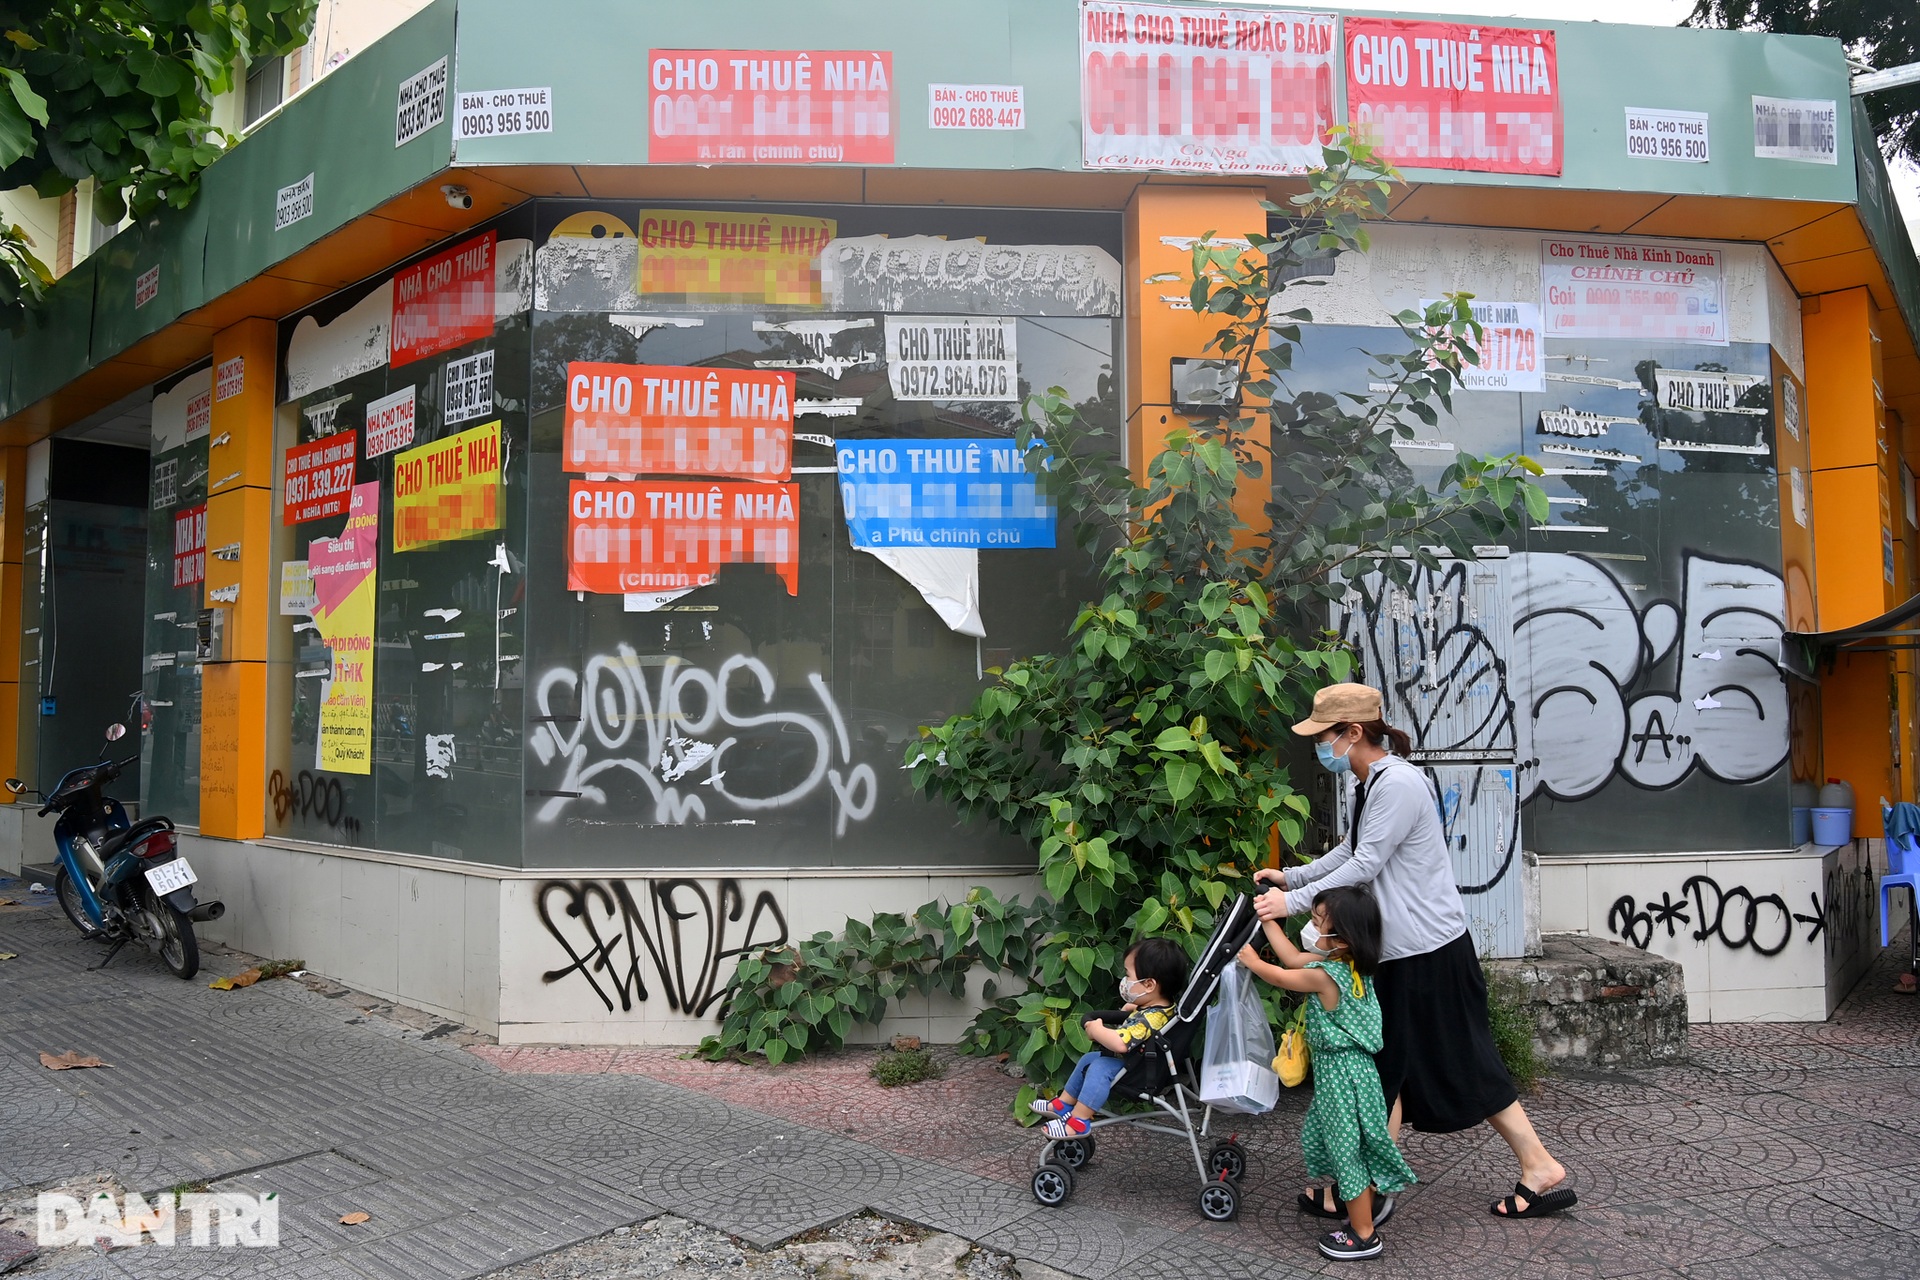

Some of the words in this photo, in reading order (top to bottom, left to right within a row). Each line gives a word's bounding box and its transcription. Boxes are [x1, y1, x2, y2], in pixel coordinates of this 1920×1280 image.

[1087, 6, 1128, 44] NHÀ
[1135, 13, 1174, 45] CHO
[1180, 12, 1229, 50] THUÊ
[1235, 14, 1288, 59] HOẶC
[1293, 17, 1332, 55] BÁN
[652, 58, 719, 91] CHO
[729, 52, 812, 91] THUÊ
[824, 52, 889, 91] NHÀ
[1353, 33, 1409, 87] CHO
[1414, 29, 1484, 92] THUÊ
[1491, 33, 1551, 96] NHÀ
[399, 80, 413, 107] NHÀ
[413, 75, 428, 99] CHO
[428, 60, 446, 90] THUÊ
[935, 87, 956, 102] BÁN
[965, 90, 988, 102] CHO
[990, 88, 1019, 103] THUÊ
[397, 104, 416, 141] 0933
[415, 95, 430, 132] 957
[430, 86, 445, 124] 550
[463, 94, 484, 110] BÁN
[493, 94, 515, 108] CHO
[517, 90, 547, 105] THUÊ
[461, 113, 495, 137] 0903
[497, 111, 522, 133] 956
[525, 110, 550, 131] 500
[934, 107, 966, 127] 0902
[1629, 117, 1649, 132] BÁN
[1656, 121, 1677, 133] CHO
[1679, 121, 1704, 136] THUÊ
[1180, 143, 1204, 157] Cô
[1211, 146, 1249, 161] Nga
[1629, 135, 1658, 155] 0903
[1661, 137, 1683, 158] 956
[1685, 139, 1707, 159] 500
[1219, 161, 1250, 172] cho
[642, 217, 696, 250] CHO
[704, 216, 770, 253] THUÊ
[780, 220, 831, 260] NHÀ
[399, 265, 422, 305] NHÀ
[427, 259, 452, 292] CHO
[455, 235, 491, 280] THUÊ
[1549, 243, 1575, 258] Cho
[1577, 244, 1610, 260] Thuê
[1613, 246, 1639, 261] Nhà
[1642, 248, 1673, 263] Kinh
[1675, 250, 1716, 267] Doanh
[1571, 265, 1643, 282] CHÍNH
[1649, 268, 1696, 286] CHỦ
[1468, 305, 1494, 324] HUÊ
[1495, 305, 1520, 325] NHÀ
[899, 327, 930, 362] CHO
[934, 320, 972, 362] THUÊ
[976, 319, 1006, 361] NHÀ
[448, 365, 459, 384] CHO
[462, 357, 478, 380] THUÊ
[480, 352, 493, 375] NHÀ
[900, 364, 1008, 398] 0972.964.076
[1487, 372, 1508, 388] CHỦ
[464, 378, 478, 407] 957
[570, 374, 633, 413] CHO
[643, 371, 721, 418] THUÊ
[730, 375, 790, 422] NHÀ
[1668, 379, 1695, 409] CHO
[1697, 376, 1731, 410] THUÊ
[367, 409, 381, 434] NHÀ
[381, 406, 395, 429] CHO
[396, 395, 414, 421] THUÊ
[366, 432, 385, 458] 0936
[385, 426, 400, 451] 075
[399, 421, 413, 446] 915
[286, 456, 298, 475] CHO
[298, 450, 312, 471] THUÊ
[311, 447, 324, 468] NHÀ
[395, 457, 424, 499] CHO
[426, 436, 463, 489] THUÊ
[468, 425, 499, 477] NHÀ
[837, 448, 897, 474] CHO
[906, 442, 982, 474] THUÊ
[285, 461, 355, 507] 0931.339.227
[572, 490, 635, 520] CHO
[645, 486, 723, 520] THUÊ
[734, 487, 795, 522] NHÀ
[195, 502, 208, 550] BÁ
[871, 530, 882, 543] a
[888, 525, 924, 544] Phú
[929, 527, 981, 545] chính
[986, 527, 1022, 545] chủ
[618, 568, 690, 591] (chính
[347, 633, 371, 654] ĐỘNG
[334, 662, 364, 683] TMK
